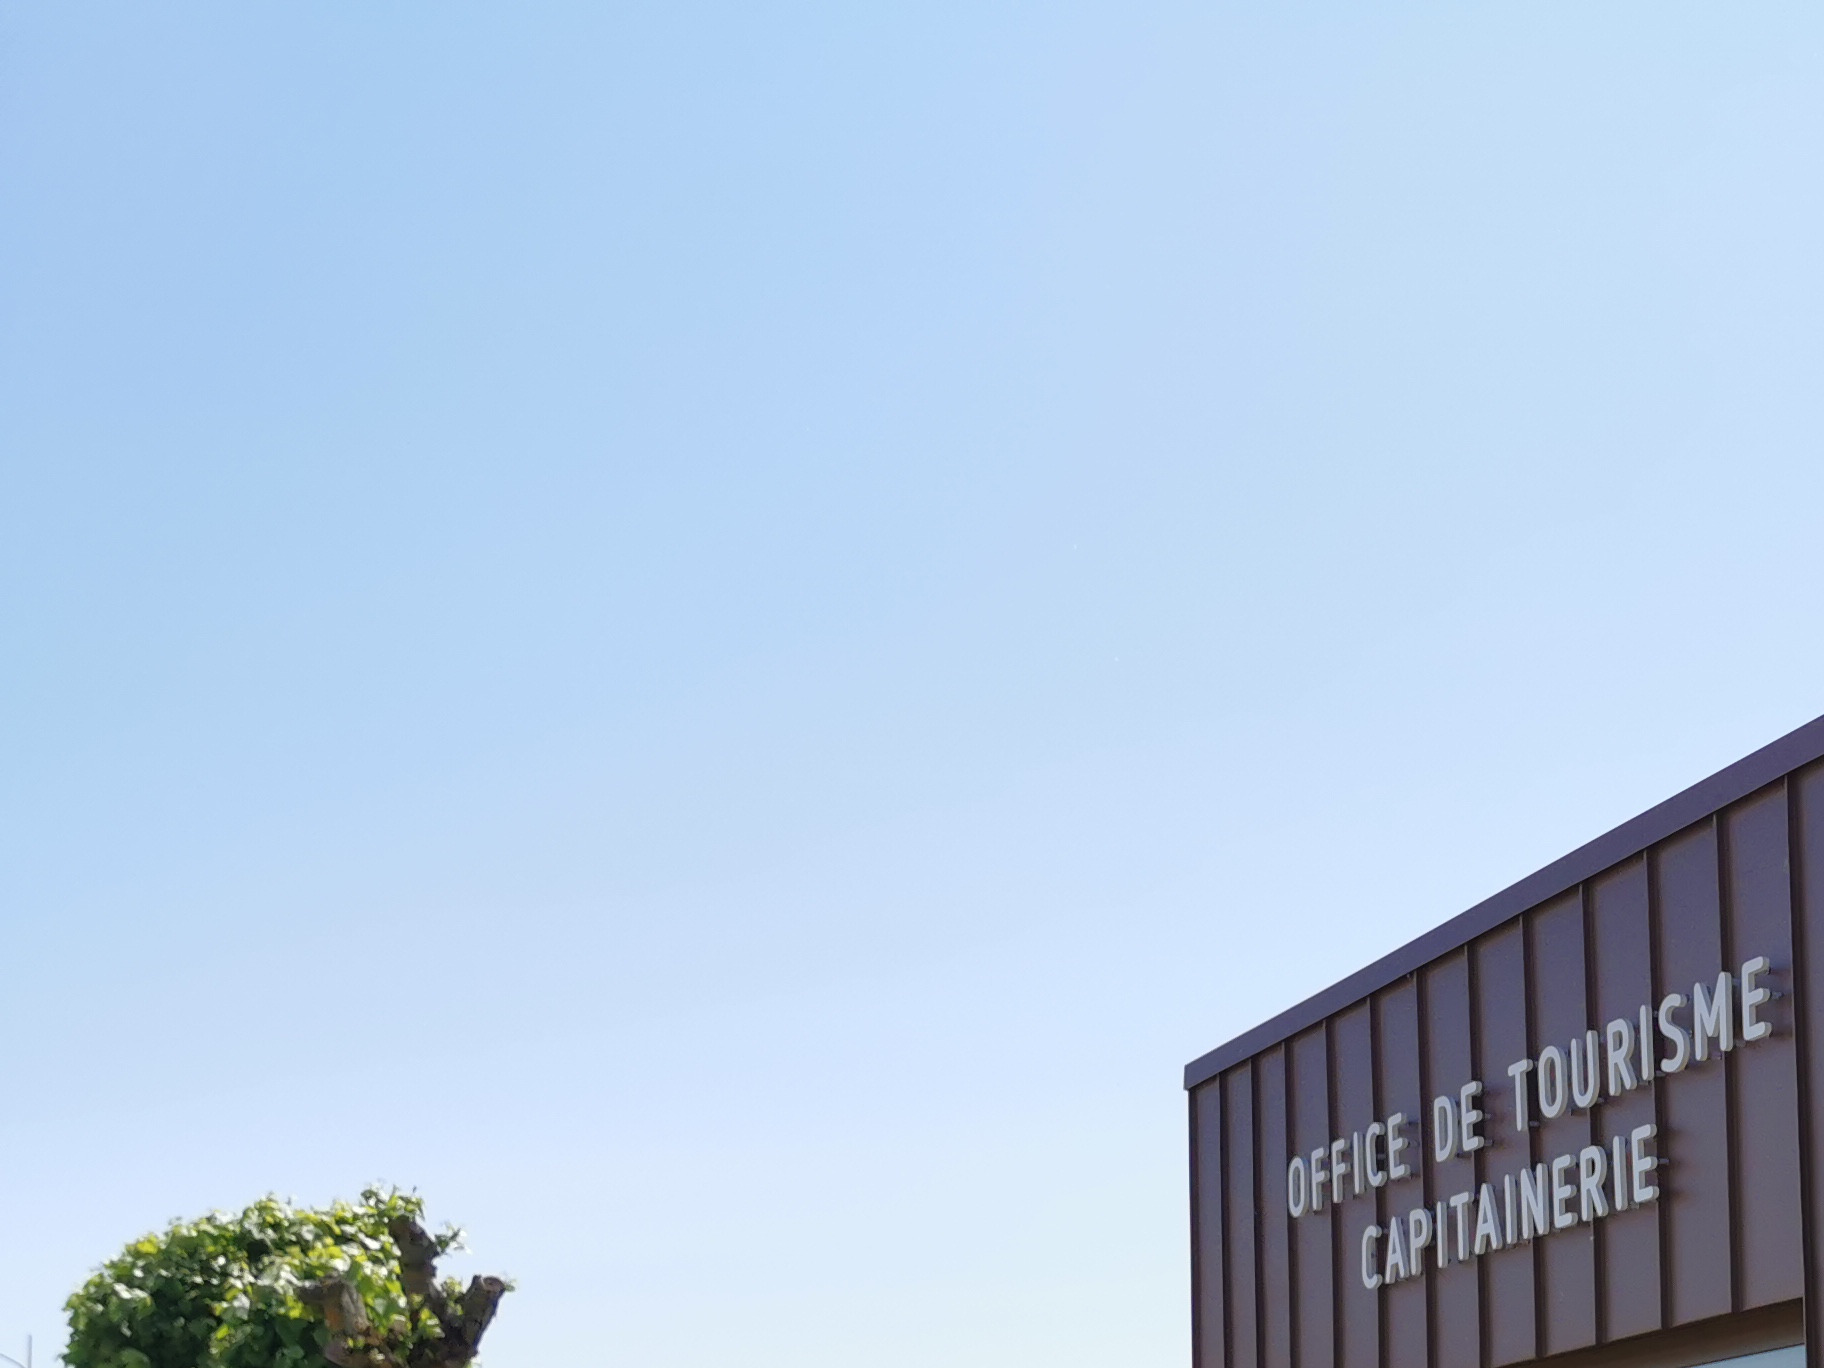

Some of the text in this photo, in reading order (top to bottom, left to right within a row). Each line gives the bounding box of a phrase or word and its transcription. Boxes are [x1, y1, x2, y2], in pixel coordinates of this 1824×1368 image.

[1288, 956, 1773, 1218] OFFICE DE TOURISME
[1361, 1124, 1659, 1289] CAPITAINERIE
